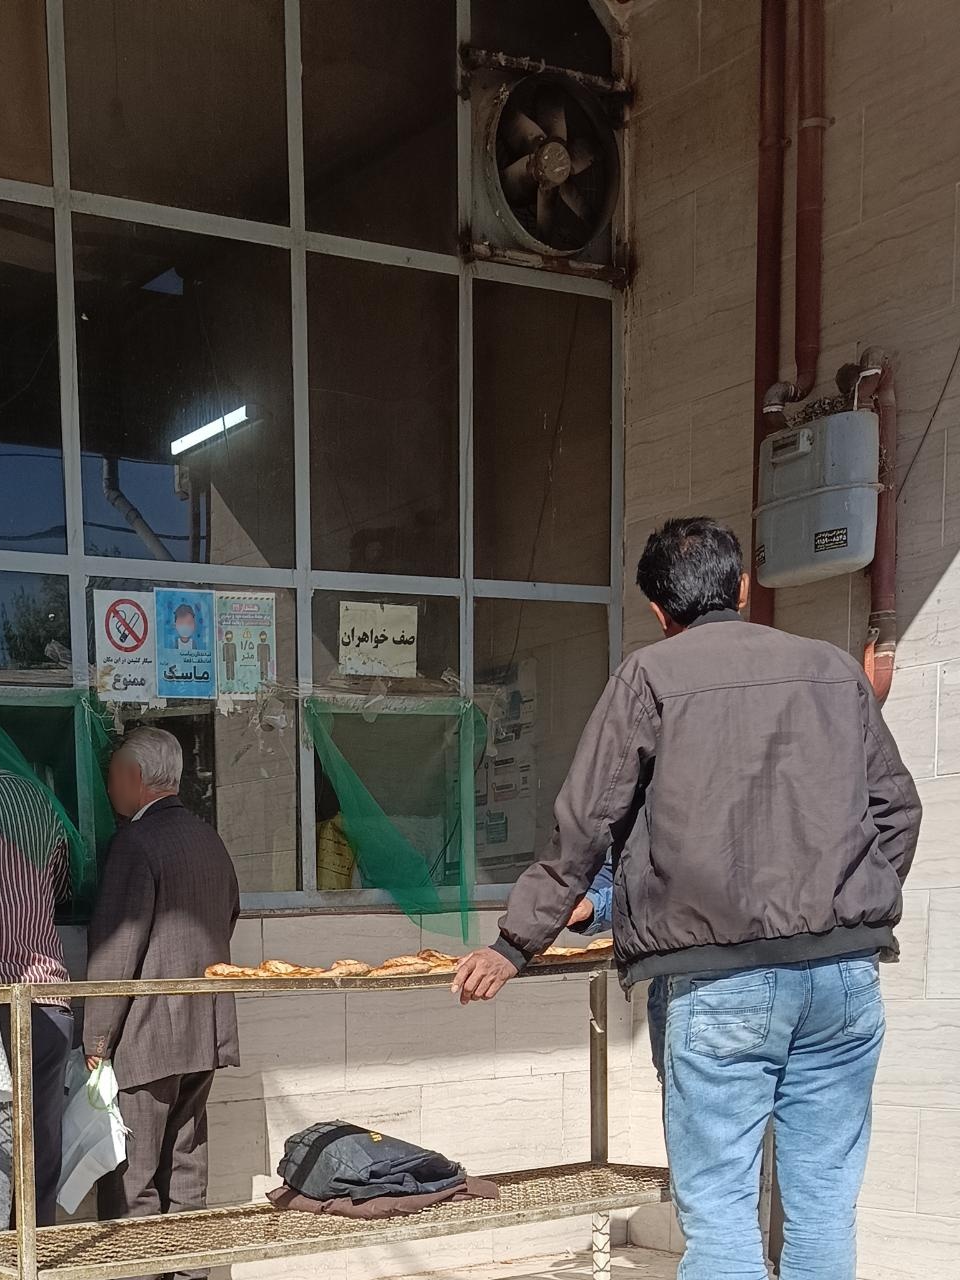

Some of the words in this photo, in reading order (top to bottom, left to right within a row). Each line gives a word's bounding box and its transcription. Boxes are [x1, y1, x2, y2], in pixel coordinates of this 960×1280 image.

[341, 626, 389, 649] خواهران
[392, 629, 416, 646] صف
[240, 639, 256, 651] ۱/۵
[102, 656, 113, 664] مکان
[126, 656, 141, 665] کشیدن
[141, 656, 153, 666] سیگار
[241, 652, 256, 663] متر
[162, 663, 211, 683] ماسک
[111, 673, 146, 691] ممنوع
